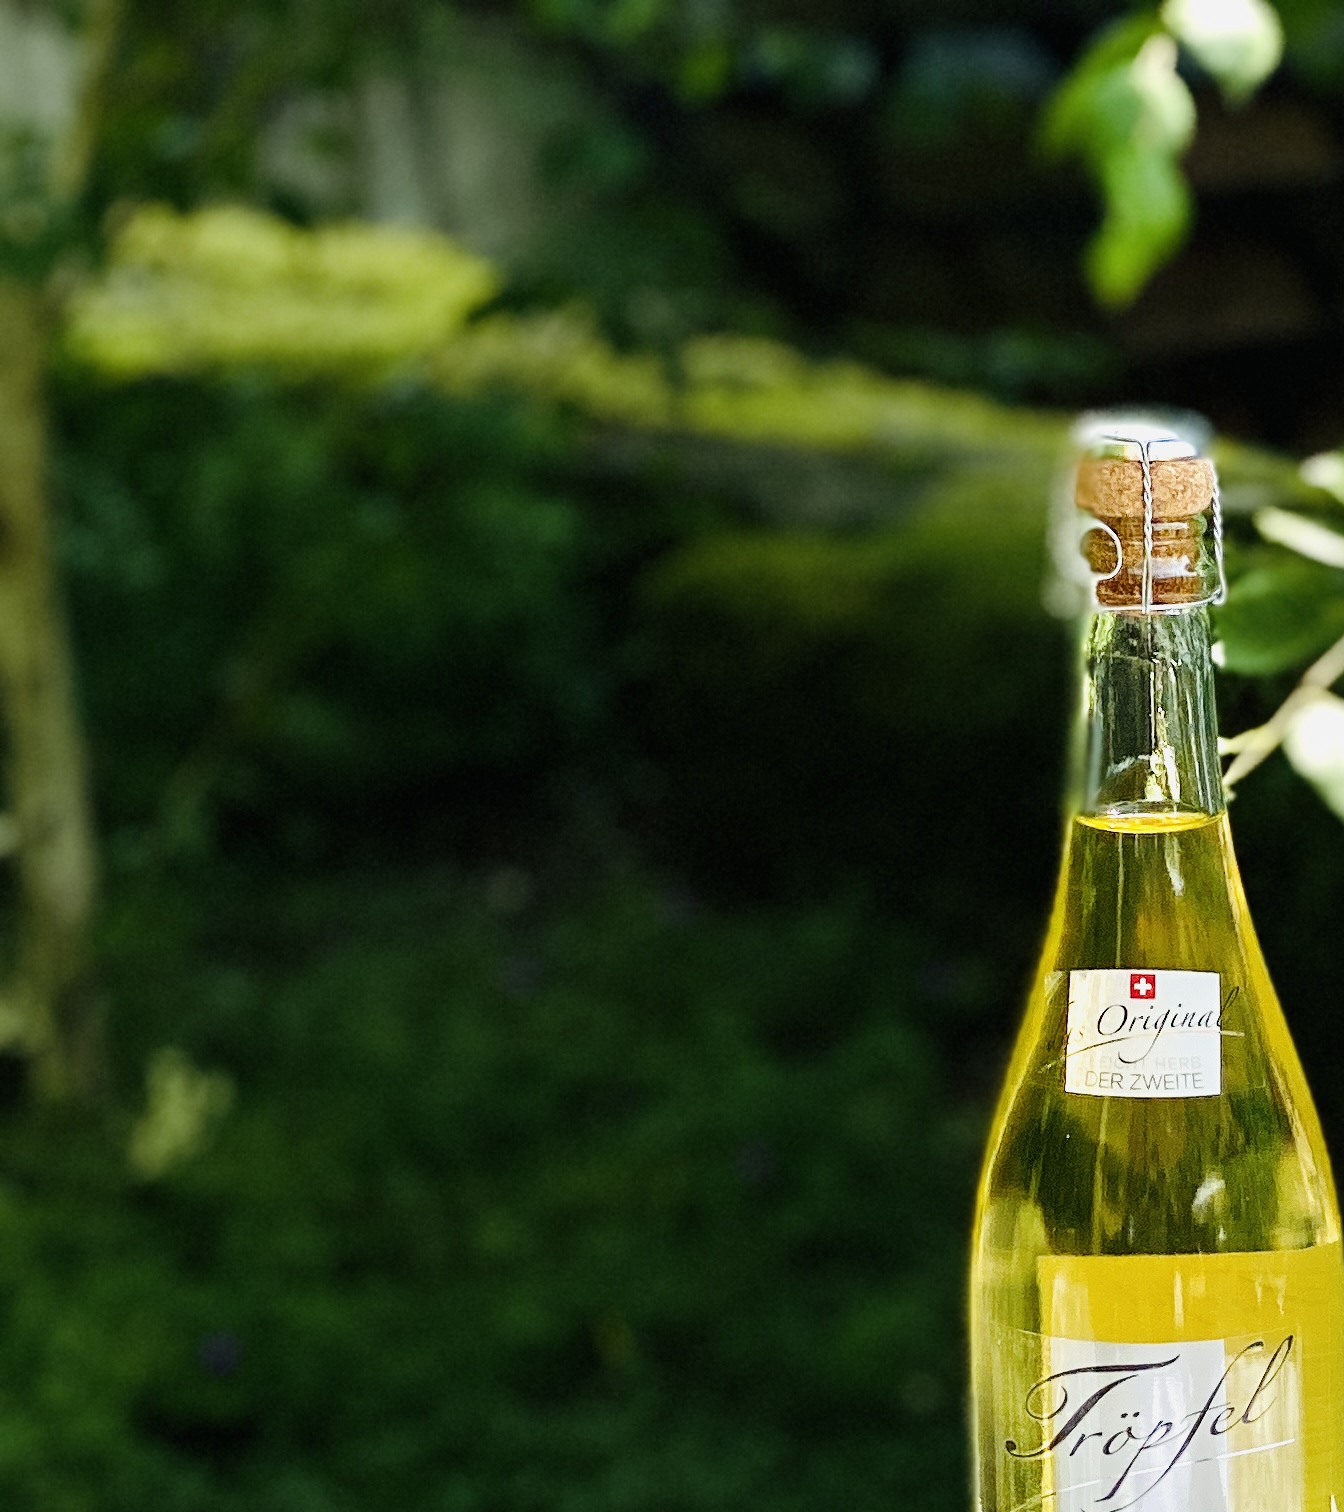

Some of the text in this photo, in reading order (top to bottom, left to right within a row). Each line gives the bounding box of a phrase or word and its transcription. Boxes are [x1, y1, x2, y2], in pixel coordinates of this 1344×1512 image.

[1096, 986, 1240, 1064] Original
[1084, 1071, 1204, 1090] DER ZWEITE
